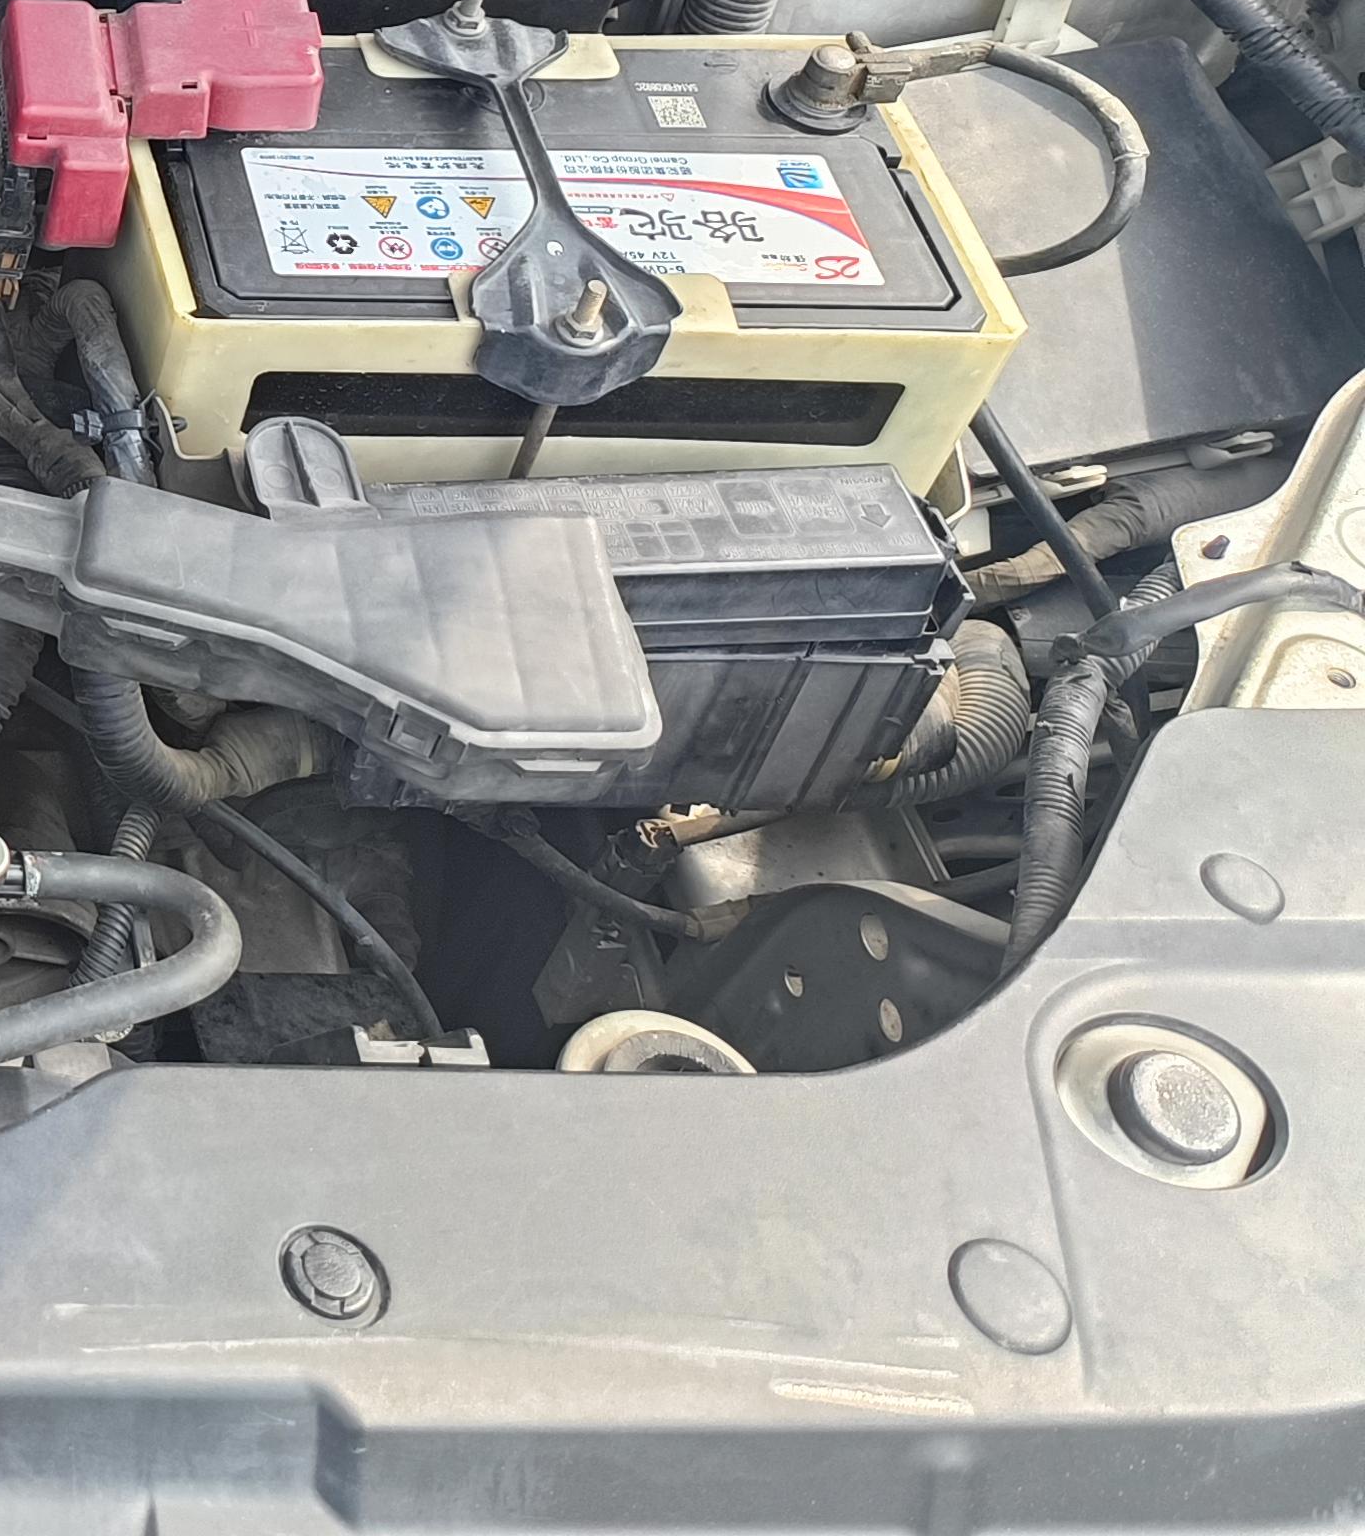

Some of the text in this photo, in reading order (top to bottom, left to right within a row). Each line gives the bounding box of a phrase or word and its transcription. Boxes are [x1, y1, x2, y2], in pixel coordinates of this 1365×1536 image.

[612, 156, 648, 164] Group
[564, 165, 692, 175] 骆驼集团股份有限公司
[619, 208, 765, 243] 骆驼
[653, 251, 677, 260] 12V
[814, 255, 860, 280] 2S
[840, 476, 884, 486] NISSAN
